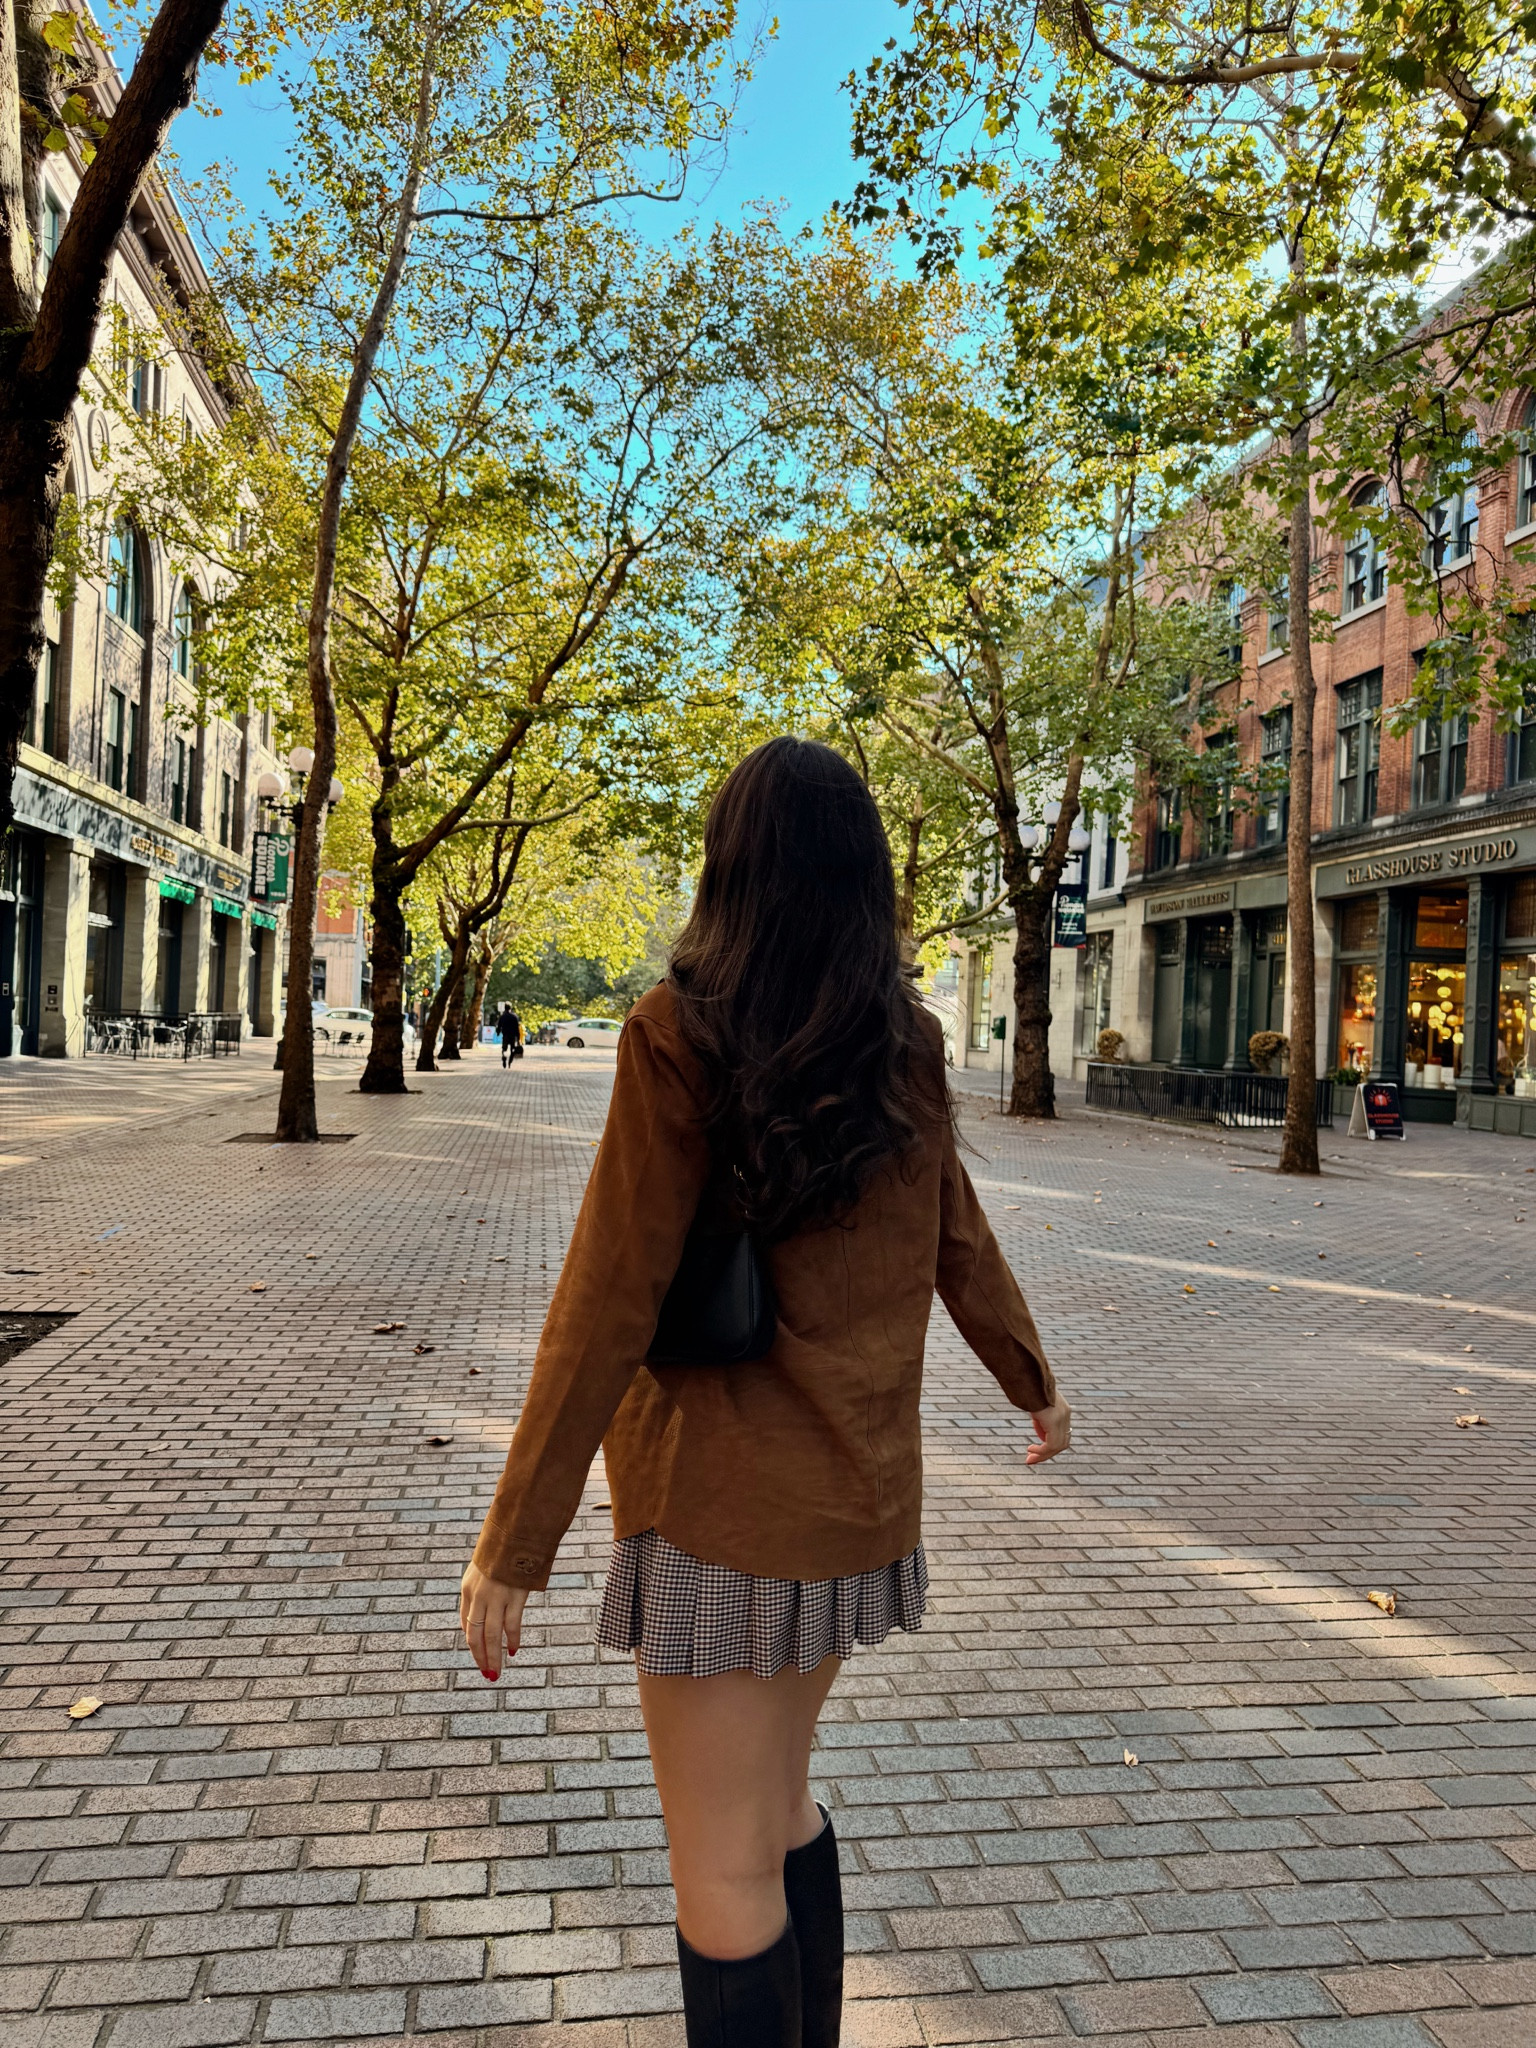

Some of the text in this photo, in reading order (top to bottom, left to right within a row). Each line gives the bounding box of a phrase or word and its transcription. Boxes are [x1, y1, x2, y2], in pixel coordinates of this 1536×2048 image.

[254, 835, 268, 895] SQUARE
[266, 836, 290, 883] Pioneer
[1345, 837, 1518, 885] GLASSHOUSE STUDIO
